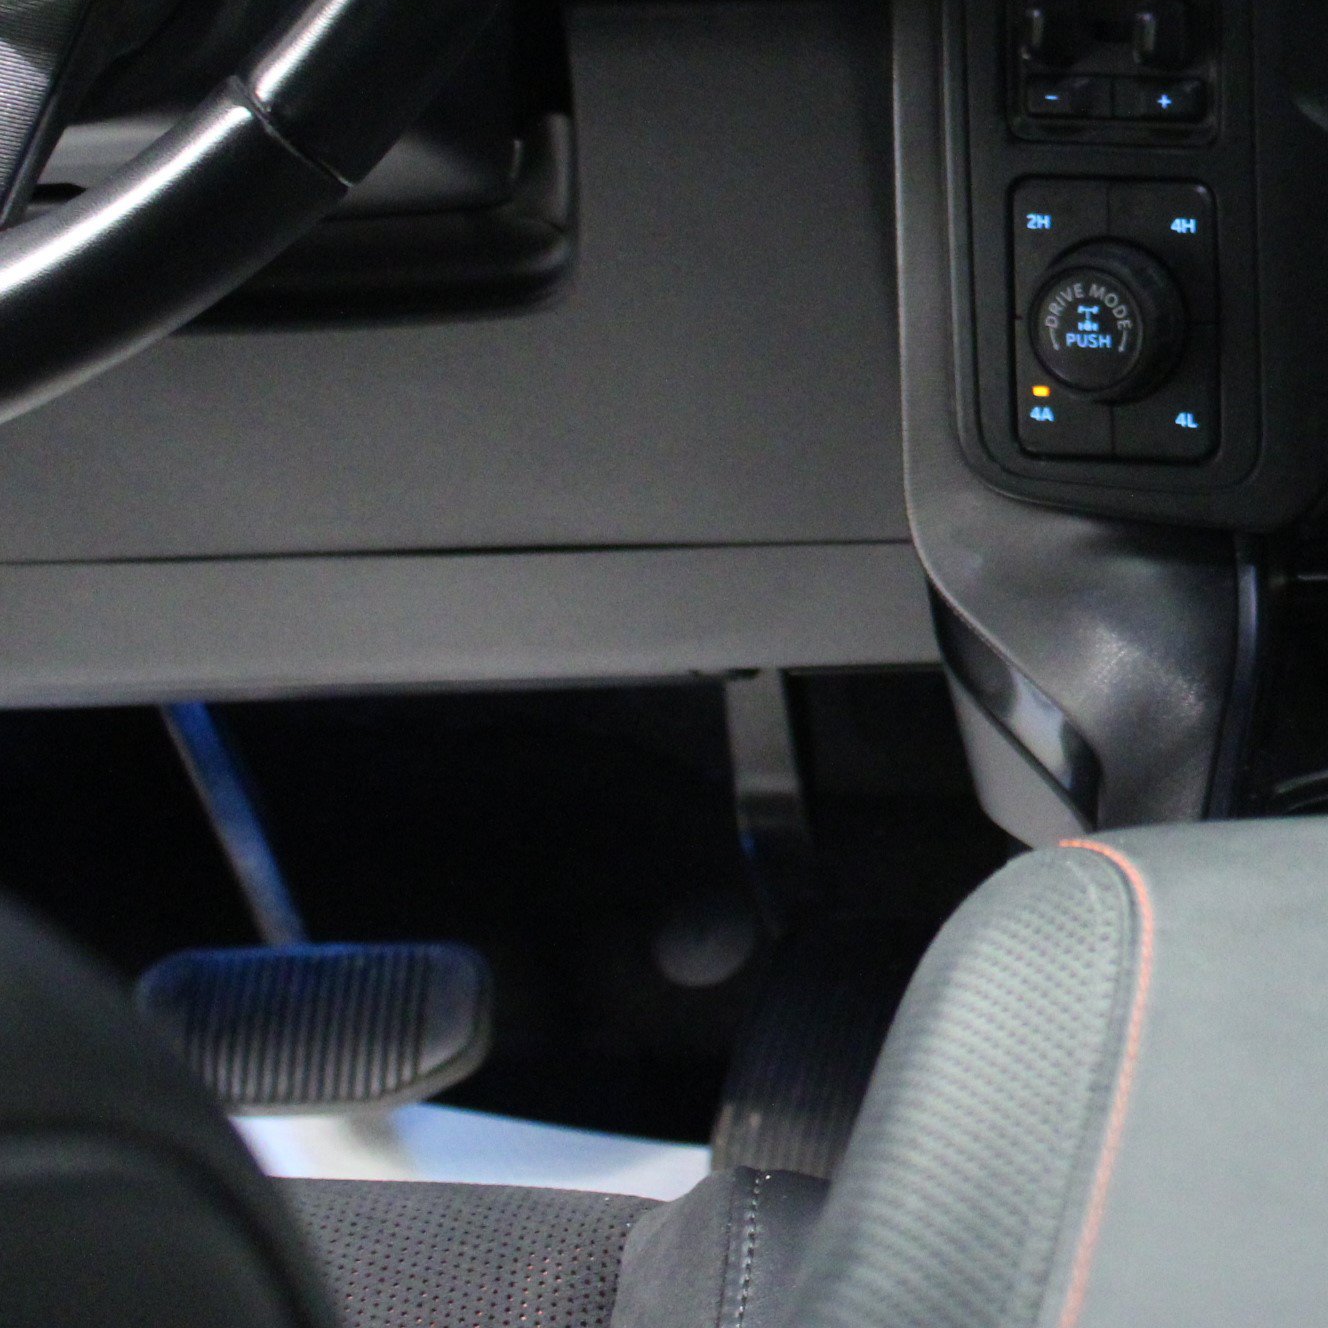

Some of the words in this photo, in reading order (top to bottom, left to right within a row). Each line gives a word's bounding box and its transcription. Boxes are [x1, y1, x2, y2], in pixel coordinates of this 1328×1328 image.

[1026, 213, 1051, 230] 2H
[1170, 218, 1196, 234] 4H
[1045, 283, 1086, 329] DRIVE
[1090, 283, 1132, 330] MODE
[1066, 333, 1112, 349] PUSH
[1029, 407, 1055, 422] 4A
[1175, 412, 1198, 429] 4L
